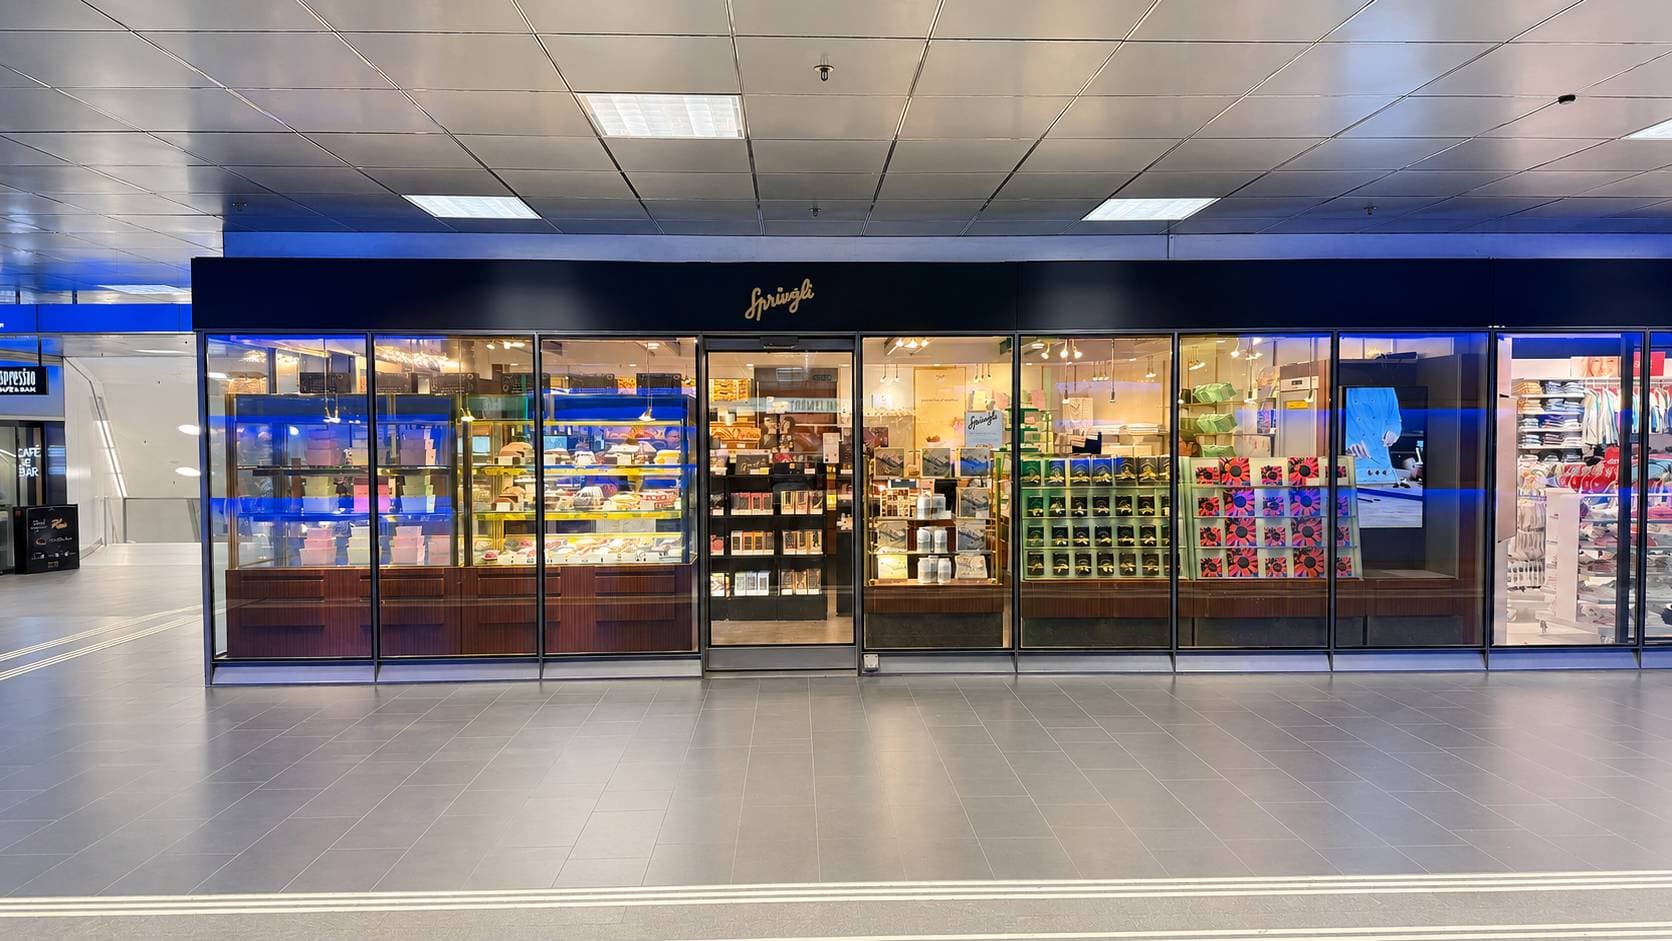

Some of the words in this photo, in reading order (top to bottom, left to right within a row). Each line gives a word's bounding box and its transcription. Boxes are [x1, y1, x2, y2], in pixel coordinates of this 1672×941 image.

[744, 278, 815, 321] Sprüngli
[18, 444, 41, 458] CAFÉ
[18, 466, 39, 478] BAR
